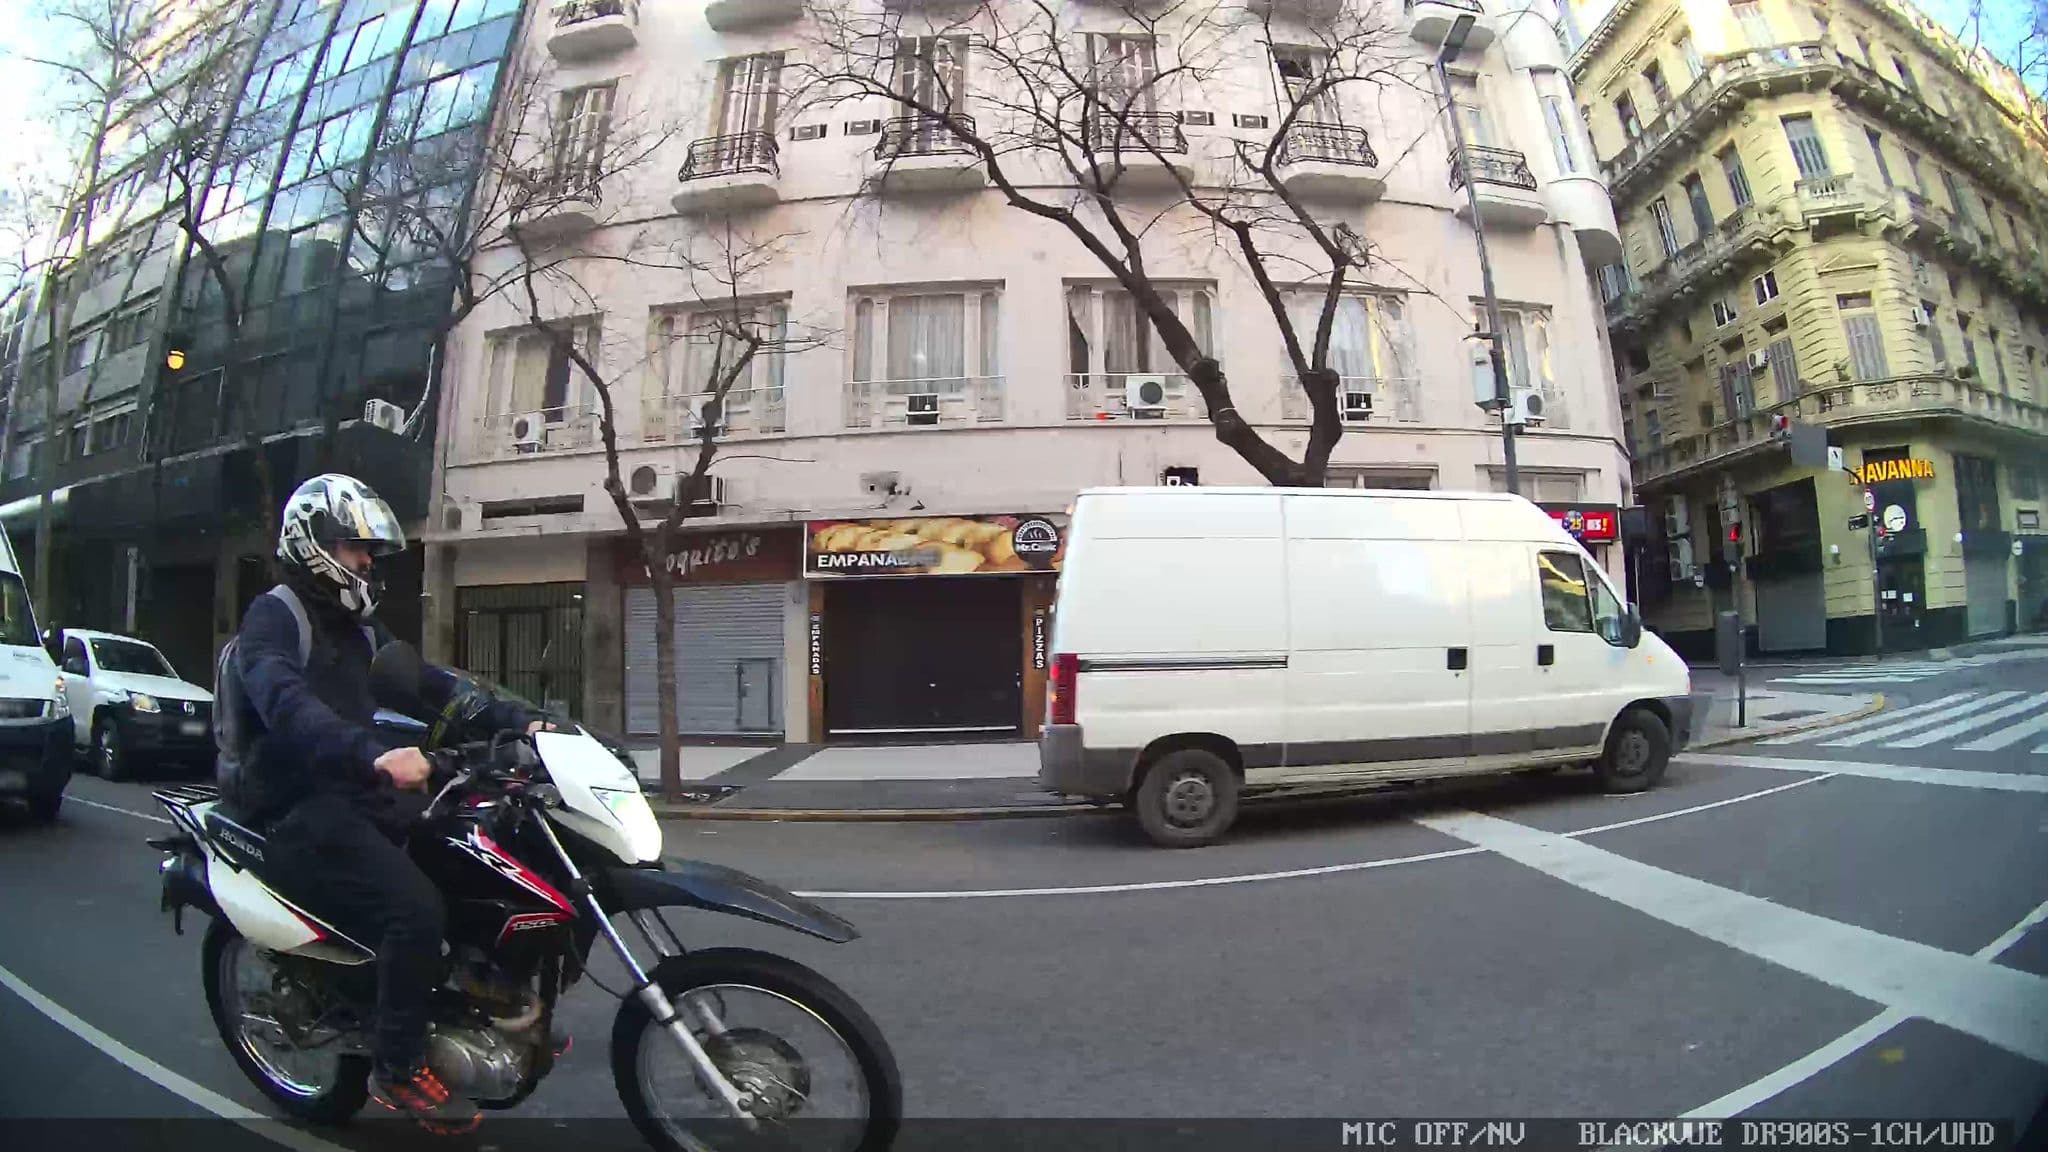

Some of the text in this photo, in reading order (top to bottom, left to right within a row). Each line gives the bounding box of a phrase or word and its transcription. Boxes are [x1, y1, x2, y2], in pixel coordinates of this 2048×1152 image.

[811, 624, 820, 674] EMPANADAS
[1035, 618, 1045, 668] PIZZAS
[220, 828, 265, 862] HONDA
